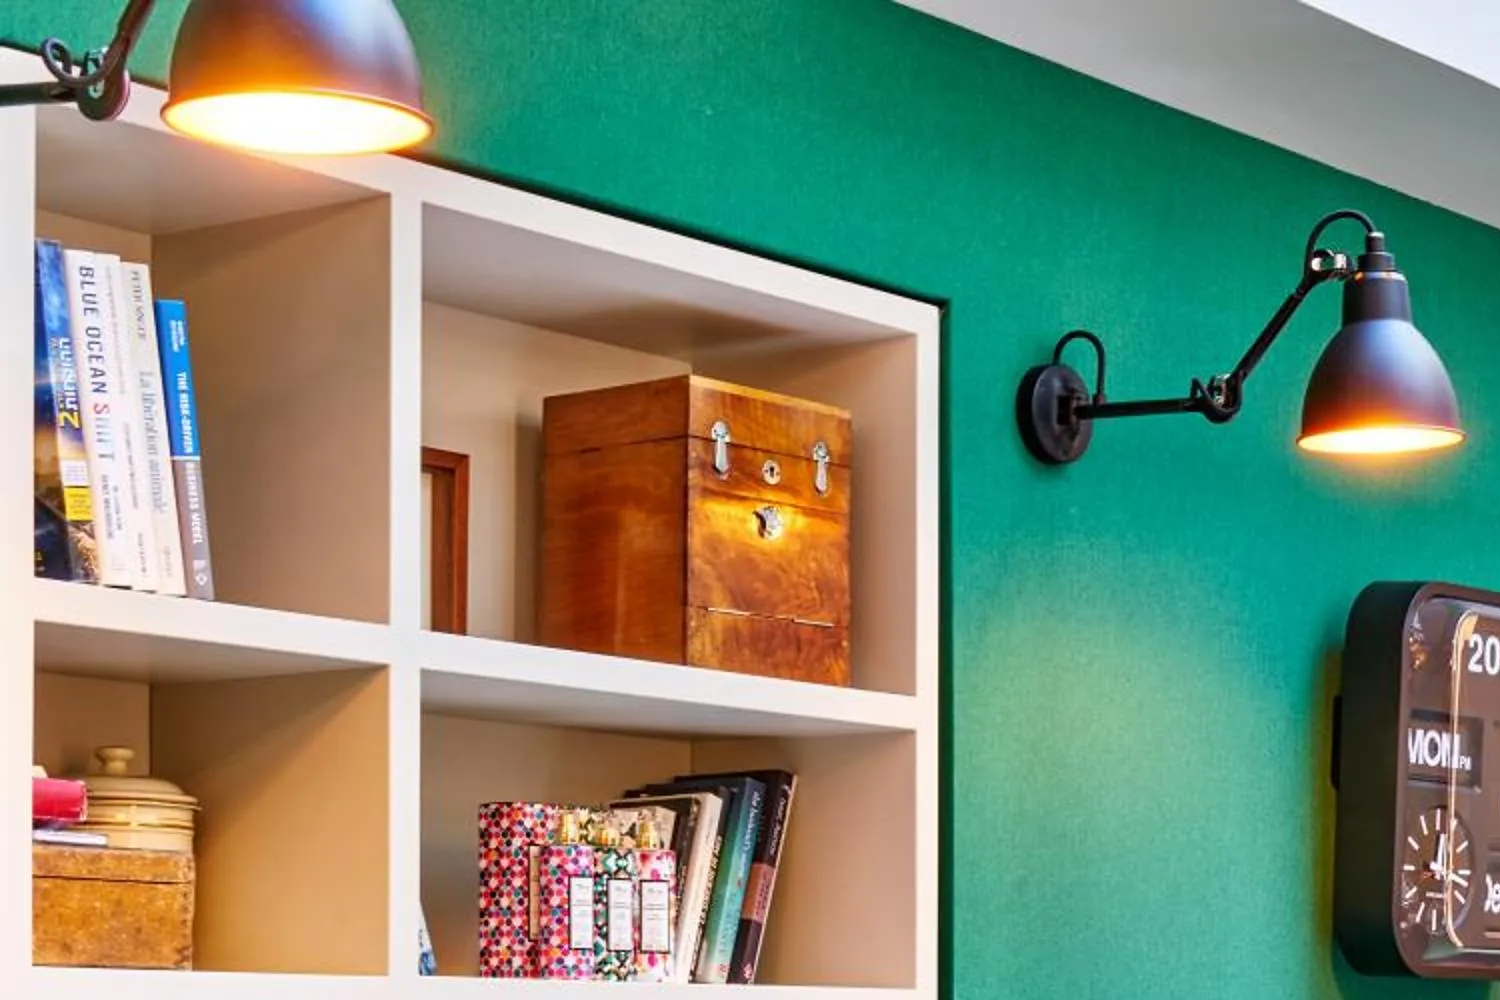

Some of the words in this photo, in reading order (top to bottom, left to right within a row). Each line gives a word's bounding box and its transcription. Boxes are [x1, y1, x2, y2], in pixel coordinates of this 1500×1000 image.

[78, 264, 99, 319] BLUE
[84, 325, 108, 395] OCEAN
[174, 370, 188, 391] THE
[93, 402, 116, 463] SHIFT
[176, 393, 197, 455] RISK-DRIVEN
[190, 513, 204, 546] MODEL
